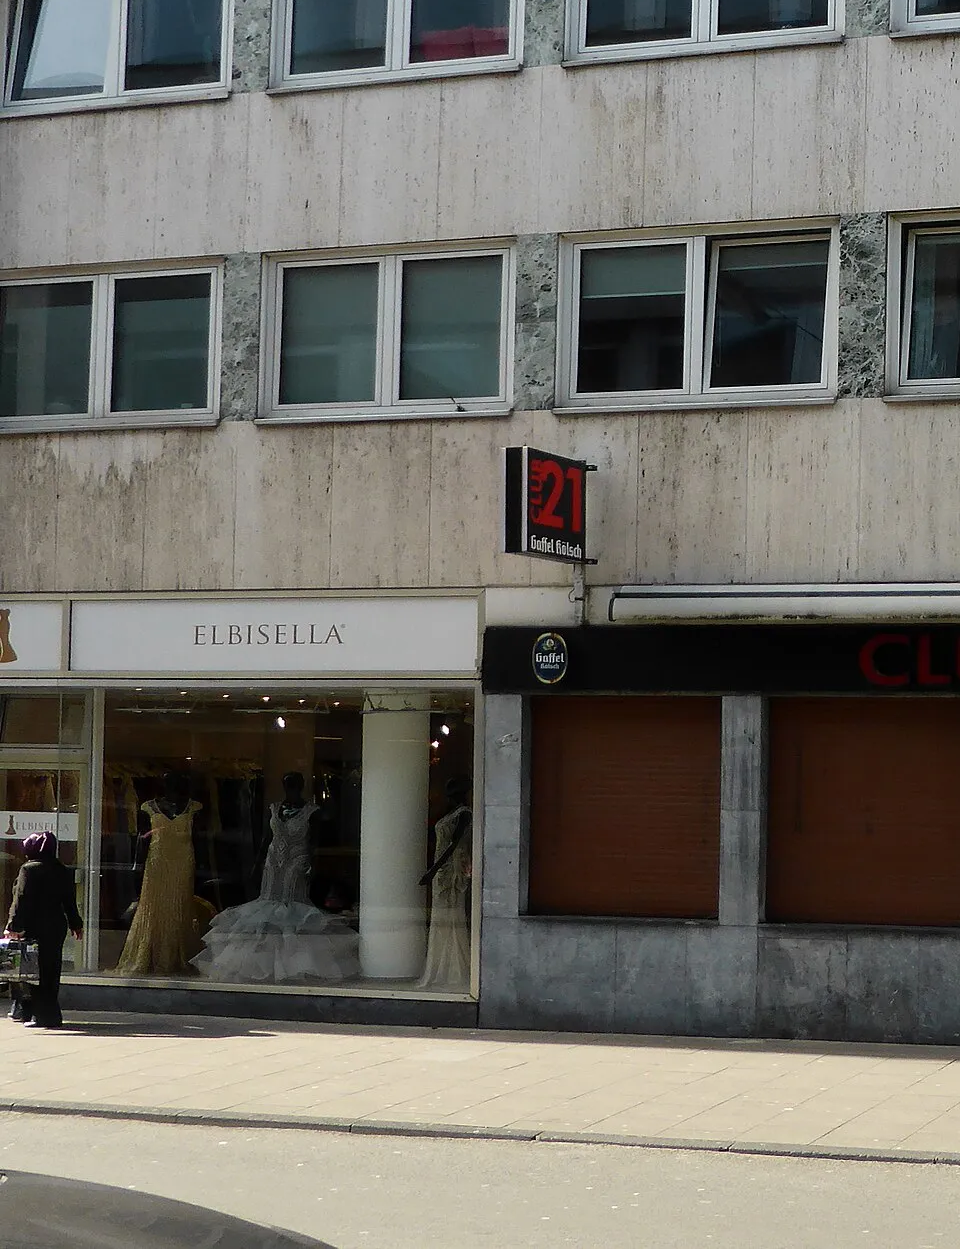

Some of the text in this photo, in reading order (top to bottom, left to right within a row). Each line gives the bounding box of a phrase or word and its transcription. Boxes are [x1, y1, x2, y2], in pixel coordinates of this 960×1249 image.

[538, 460, 582, 533] 21
[530, 534, 582, 559] Gaffel Kölsch
[535, 652, 565, 664] Gaffel
